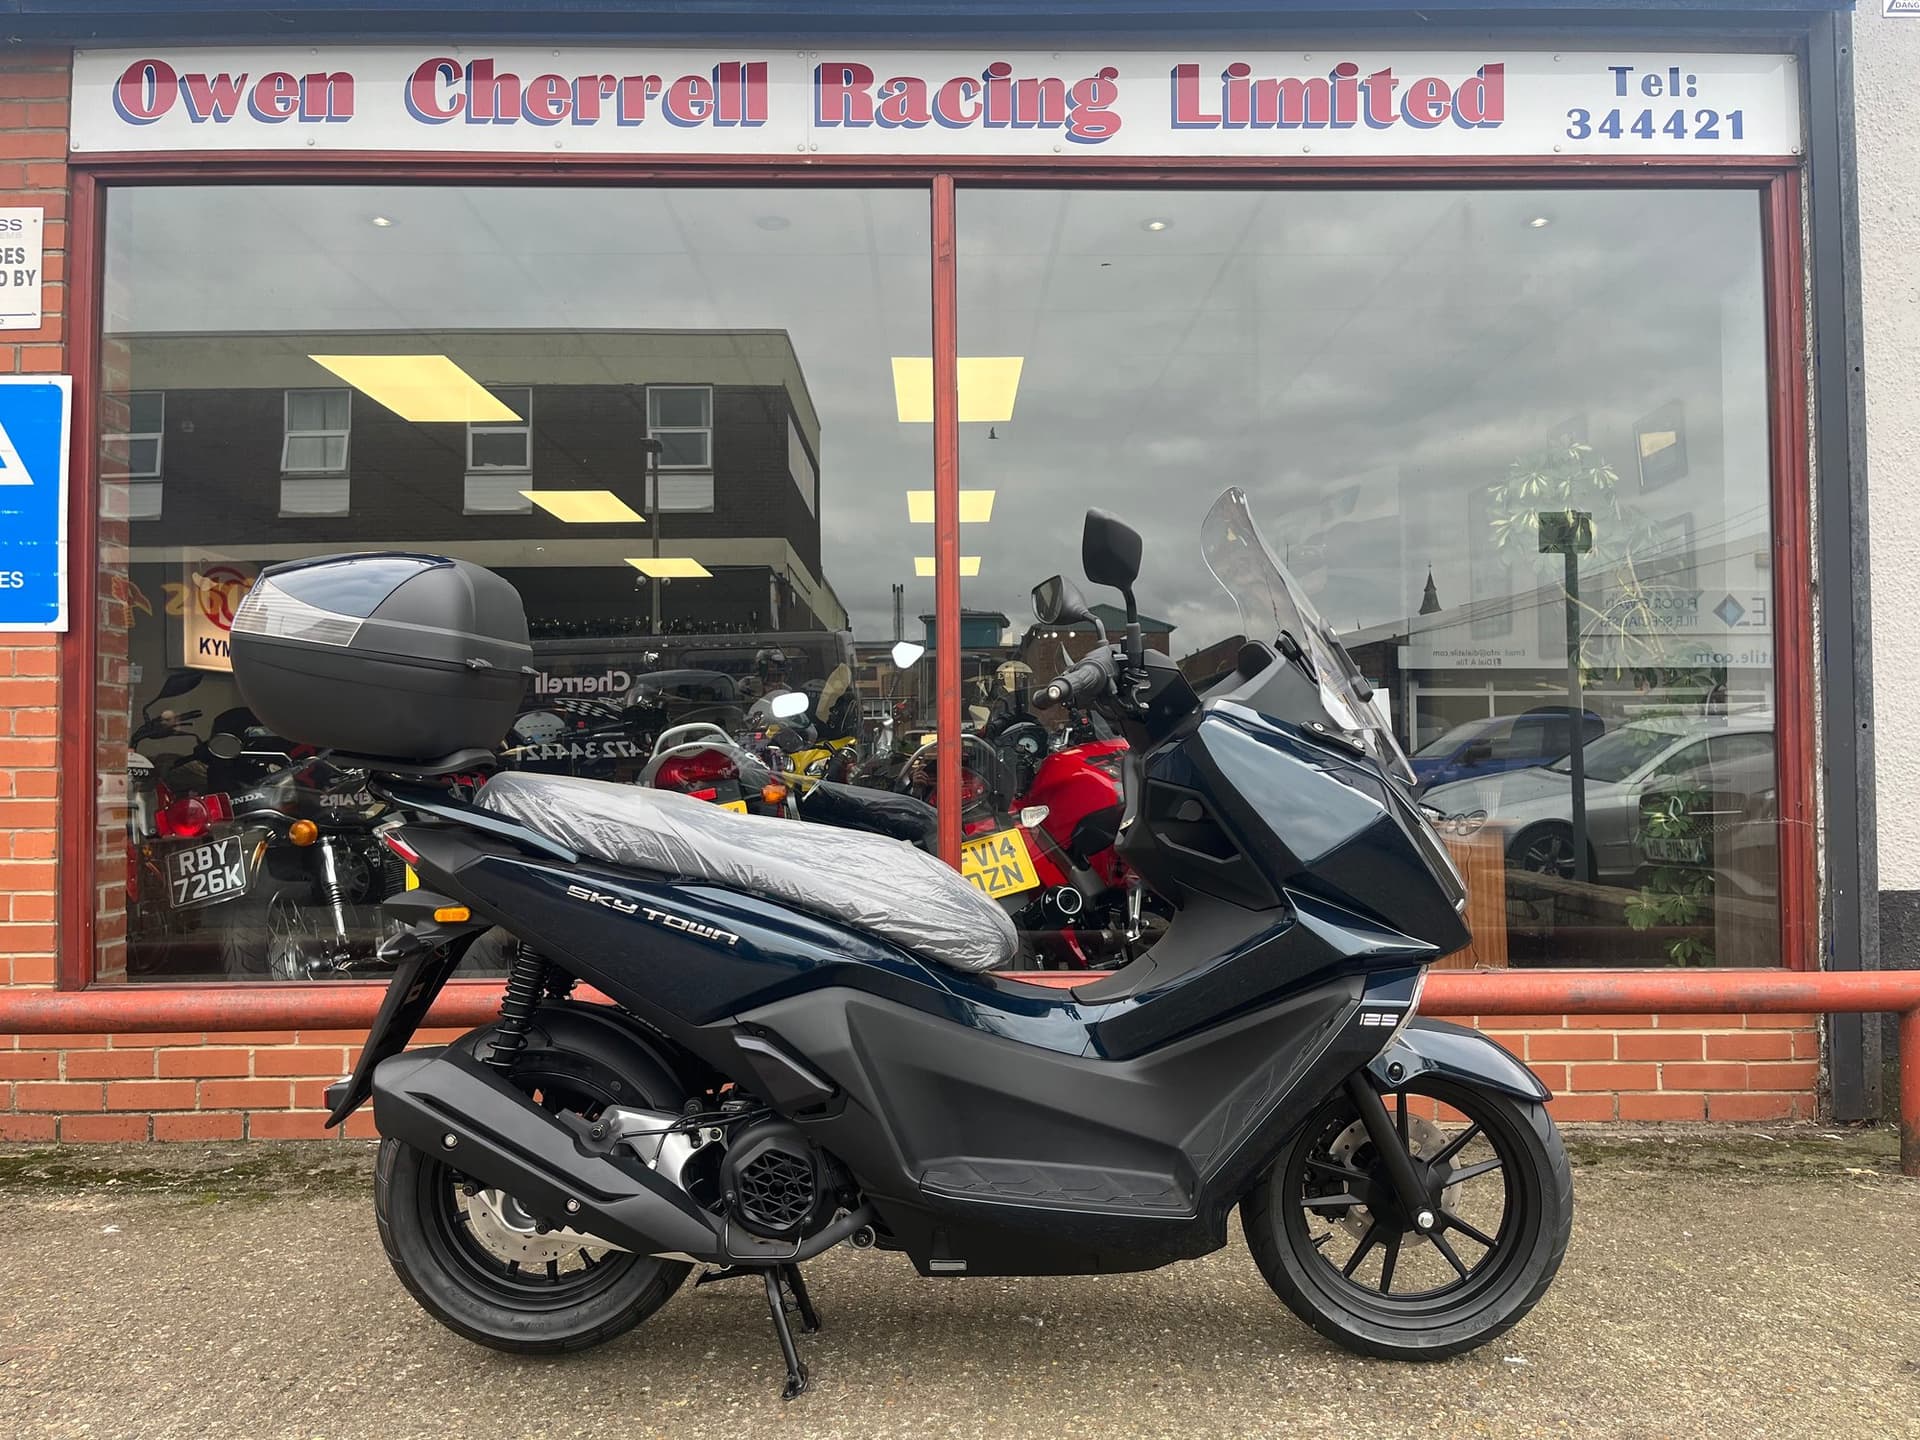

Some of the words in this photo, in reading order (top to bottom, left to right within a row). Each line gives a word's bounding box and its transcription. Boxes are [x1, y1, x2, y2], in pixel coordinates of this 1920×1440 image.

[1608, 66, 1698, 98] Tel:
[112, 58, 354, 126] Owen
[404, 57, 768, 127] Cherrell
[814, 61, 1122, 144] Racing
[1170, 62, 1505, 129] Limited
[1566, 108, 1744, 140] 344421
[0, 247, 26, 265] ES
[14, 269, 36, 287] BY
[178, 841, 229, 876] RBY
[173, 863, 242, 904] 726K
[566, 884, 639, 914] SKY
[1359, 1013, 1399, 1026] 125
